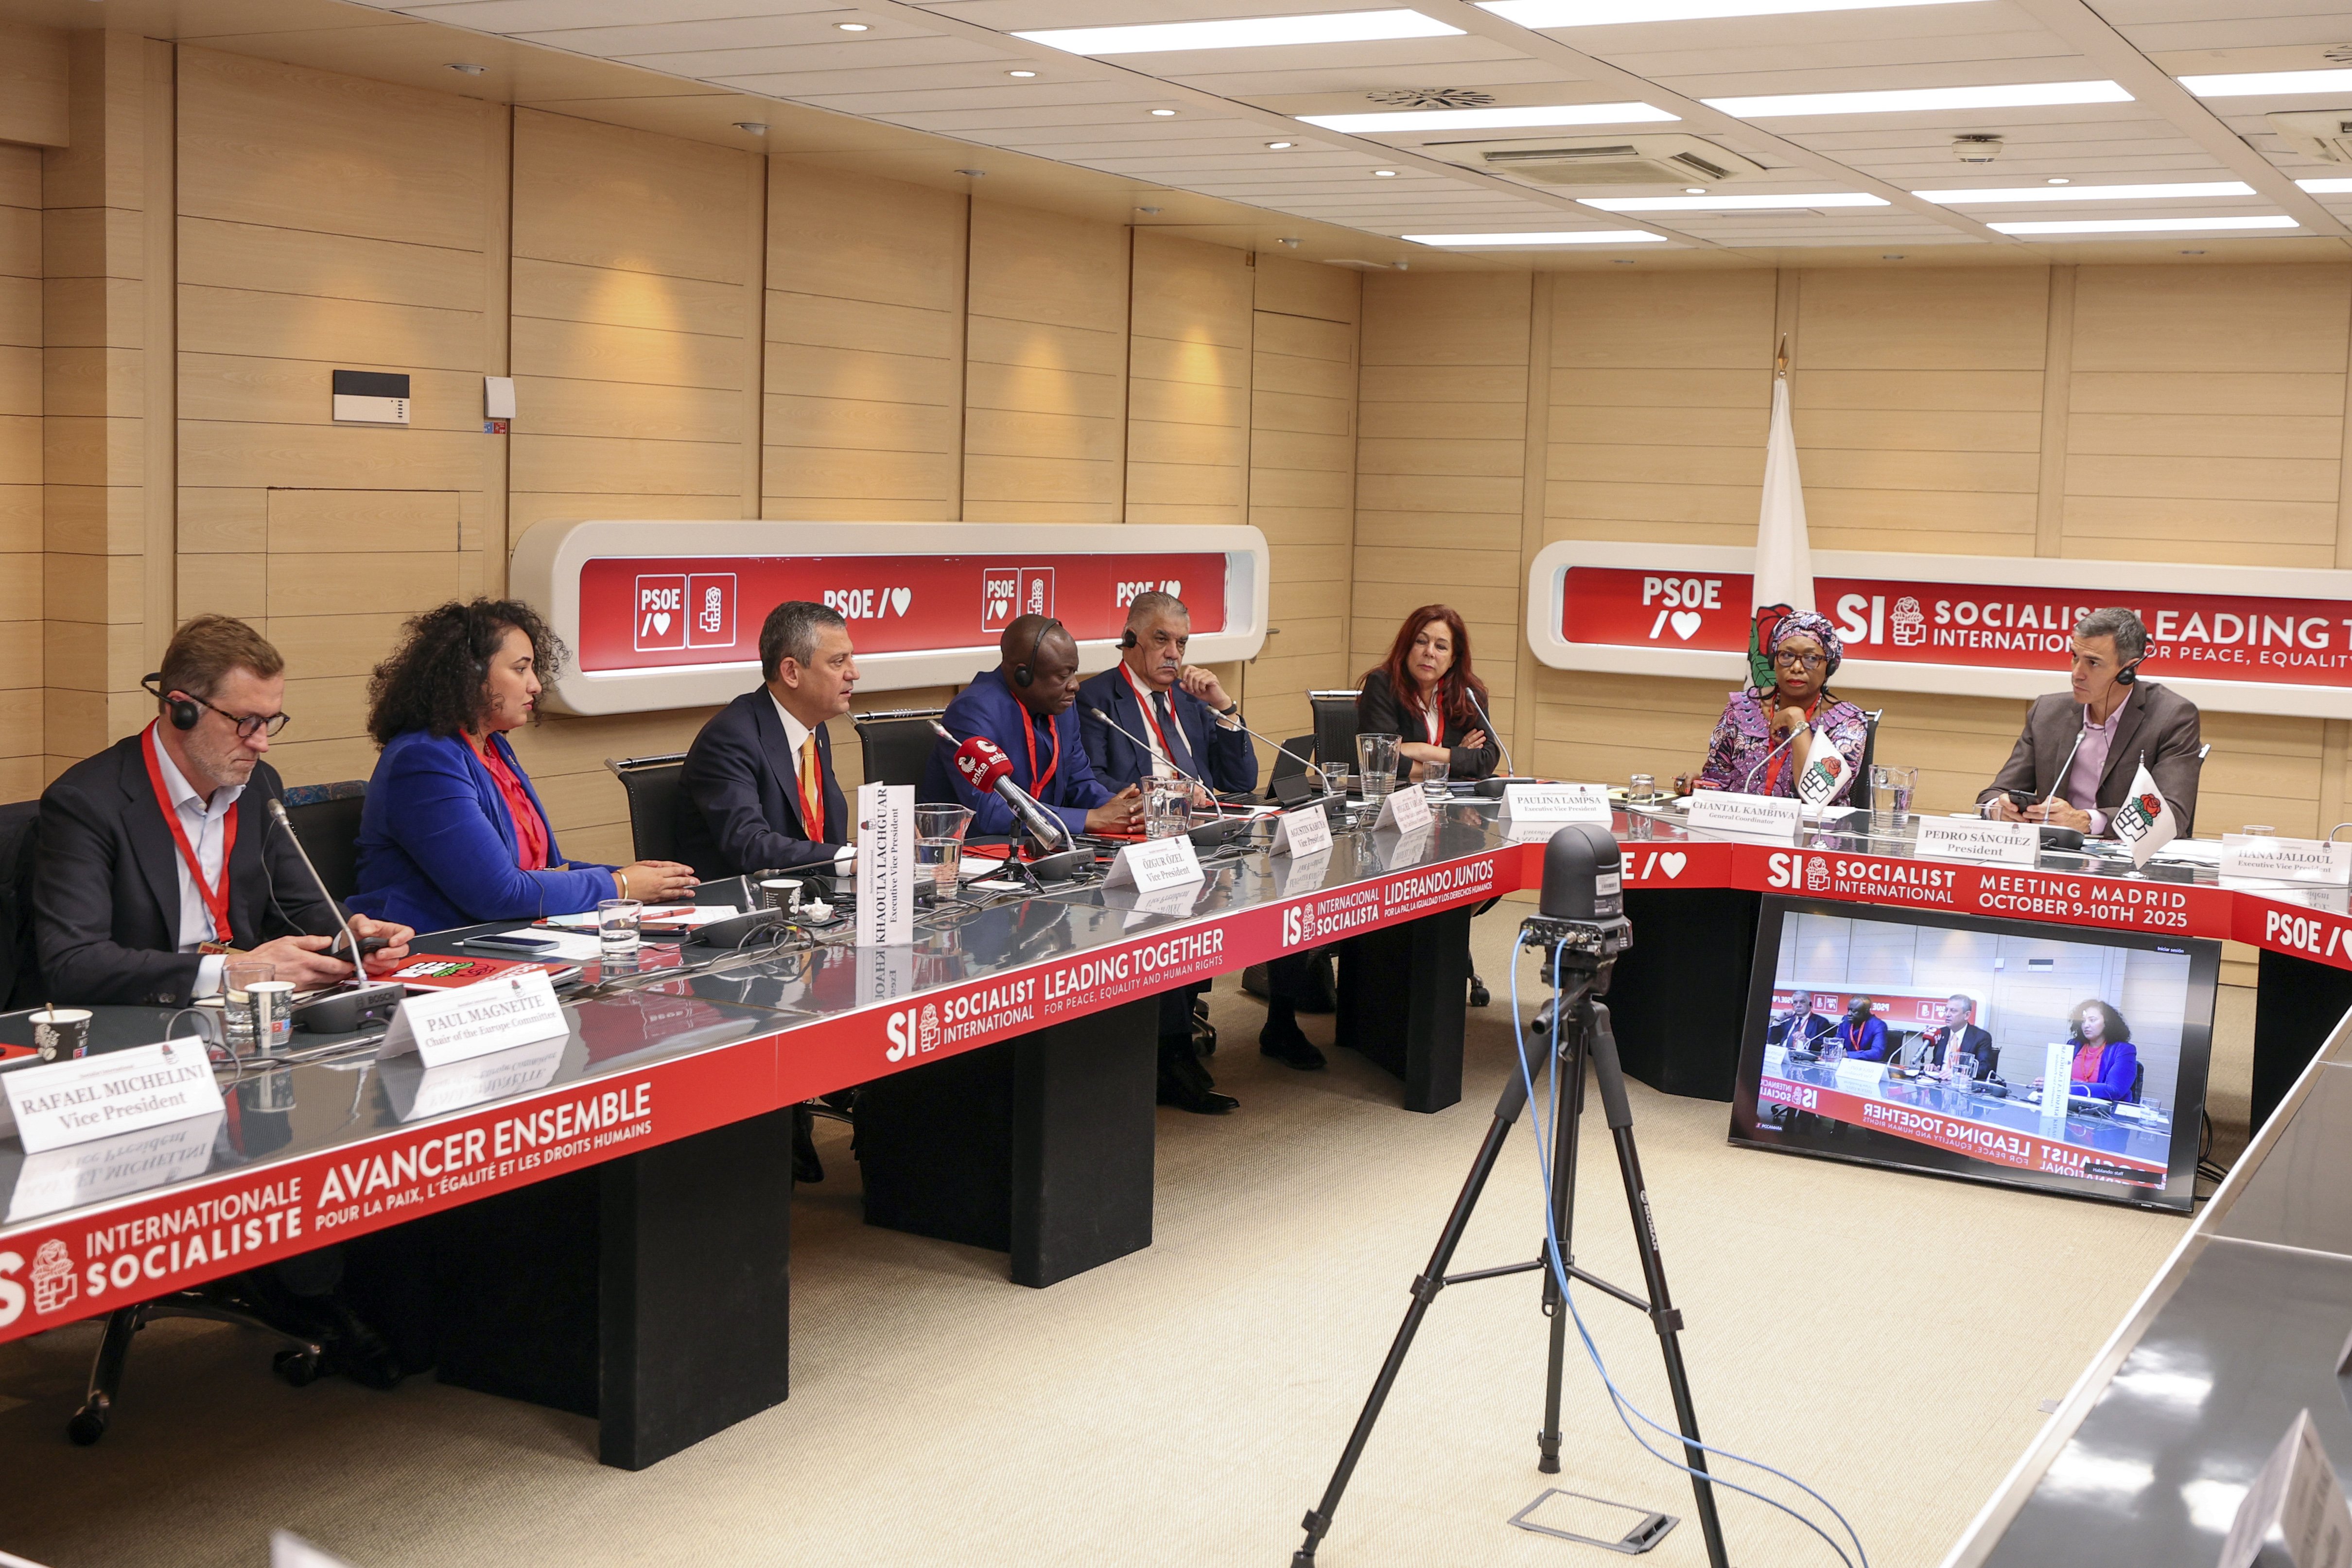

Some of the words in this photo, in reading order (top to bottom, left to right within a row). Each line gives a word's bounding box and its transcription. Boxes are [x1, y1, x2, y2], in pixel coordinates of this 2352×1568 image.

[641, 588, 680, 610] PSOE
[824, 589, 873, 619] PSOE
[987, 580, 1014, 598] PSOE
[1643, 577, 1722, 609] PSOE
[1835, 593, 1885, 645] SI
[1934, 600, 2104, 630] SOCIALIS
[2143, 645, 2171, 658] OR
[2180, 647, 2250, 665] PEACE,
[2260, 651, 2352, 668] EQUALIT
[972, 763, 988, 784] anka
[988, 752, 1007, 763] anka
[877, 788, 888, 868] LACHGUAR
[1693, 801, 1741, 814] CHANTAL
[1742, 806, 1794, 820] KAMBIWA
[1709, 813, 1734, 821] General
[1735, 815, 1775, 825] Coordinator
[1925, 830, 1967, 841] PEDRO
[1970, 832, 2031, 846] SÁNCHEZ
[1947, 844, 2003, 856] President
[1146, 871, 1161, 882] Vice
[1161, 866, 1190, 879] President
[1166, 853, 1185, 865] ÖZEL
[1767, 853, 1802, 889] SI
[1836, 860, 1956, 888] SOCIALIST
[2238, 850, 2273, 860] HANA
[2276, 853, 2333, 864] JALLOUL
[2238, 860, 2274, 869] Executive
[2294, 864, 2331, 873] President
[1384, 870, 1451, 906] LIDERANDO
[1453, 859, 1494, 888] JUNTOS
[1384, 909, 1394, 918] POR
[1394, 907, 1401, 916] LA
[1401, 905, 1410, 914] PAZ,
[1410, 903, 1416, 912] LA
[1417, 896, 1438, 906] IGUALDAD
[1442, 893, 1450, 903] LOS
[1450, 889, 1472, 900] DERECHOS
[1472, 882, 1492, 894] HUMANOS
[1835, 879, 1954, 904] INTERNATIONAL
[1980, 874, 2081, 898] MEETING
[2091, 886, 2186, 908] MADRID
[876, 871, 887, 943] KHAOULA
[1317, 888, 1379, 915] INTERNACIONAL
[1979, 892, 2068, 915] OCTOBER
[2073, 903, 2134, 923] 9-10TH
[2143, 909, 2188, 928] 2025
[1282, 906, 1302, 948] IS
[1317, 904, 1379, 937] SOCIALISTA
[2266, 910, 2322, 954] PSOE
[1044, 951, 1128, 1001] LEADING
[1132, 928, 1223, 972] TOGETHER
[368, 992, 394, 1004] BOSCH
[944, 978, 1035, 1023] SOCIALIST
[1044, 1003, 1063, 1016] FOR
[1066, 993, 1098, 1010] PEACE,
[1100, 978, 1141, 1000] EQUALITY
[1143, 973, 1161, 987] AND
[1164, 964, 1193, 981] HUMAN
[1195, 955, 1223, 972] RIGHTS
[426, 1035, 451, 1047] Chair
[453, 1032, 463, 1041] of
[463, 1029, 479, 1039] the
[480, 1022, 510, 1036] Europe
[512, 1010, 557, 1027] Committee
[427, 1015, 467, 1032] PAUL
[470, 995, 544, 1023] MAGNETTE
[943, 1009, 1034, 1044] INTERNATIONAL
[886, 1009, 916, 1063] SI
[21, 1086, 101, 1115] RAFAEL
[104, 1064, 207, 1098] MICHELINI
[59, 1112, 101, 1130] Vice
[103, 1092, 187, 1120] President
[316, 1128, 486, 1209] AVANCER
[494, 1082, 651, 1158] ENSEMBLE
[315, 1205, 359, 1231] POUR
[364, 1198, 383, 1217] LA
[386, 1186, 424, 1211] PAIX,
[499, 1159, 515, 1177] ET
[518, 1153, 541, 1172] LES
[544, 1138, 591, 1164] DROITS
[593, 1120, 652, 1149] HUMAINS
[86, 1177, 302, 1259] INTERNATIONALE
[1644, 1205, 1658, 1251] MOMAN
[87, 1208, 302, 1296] SOCIALISTE
